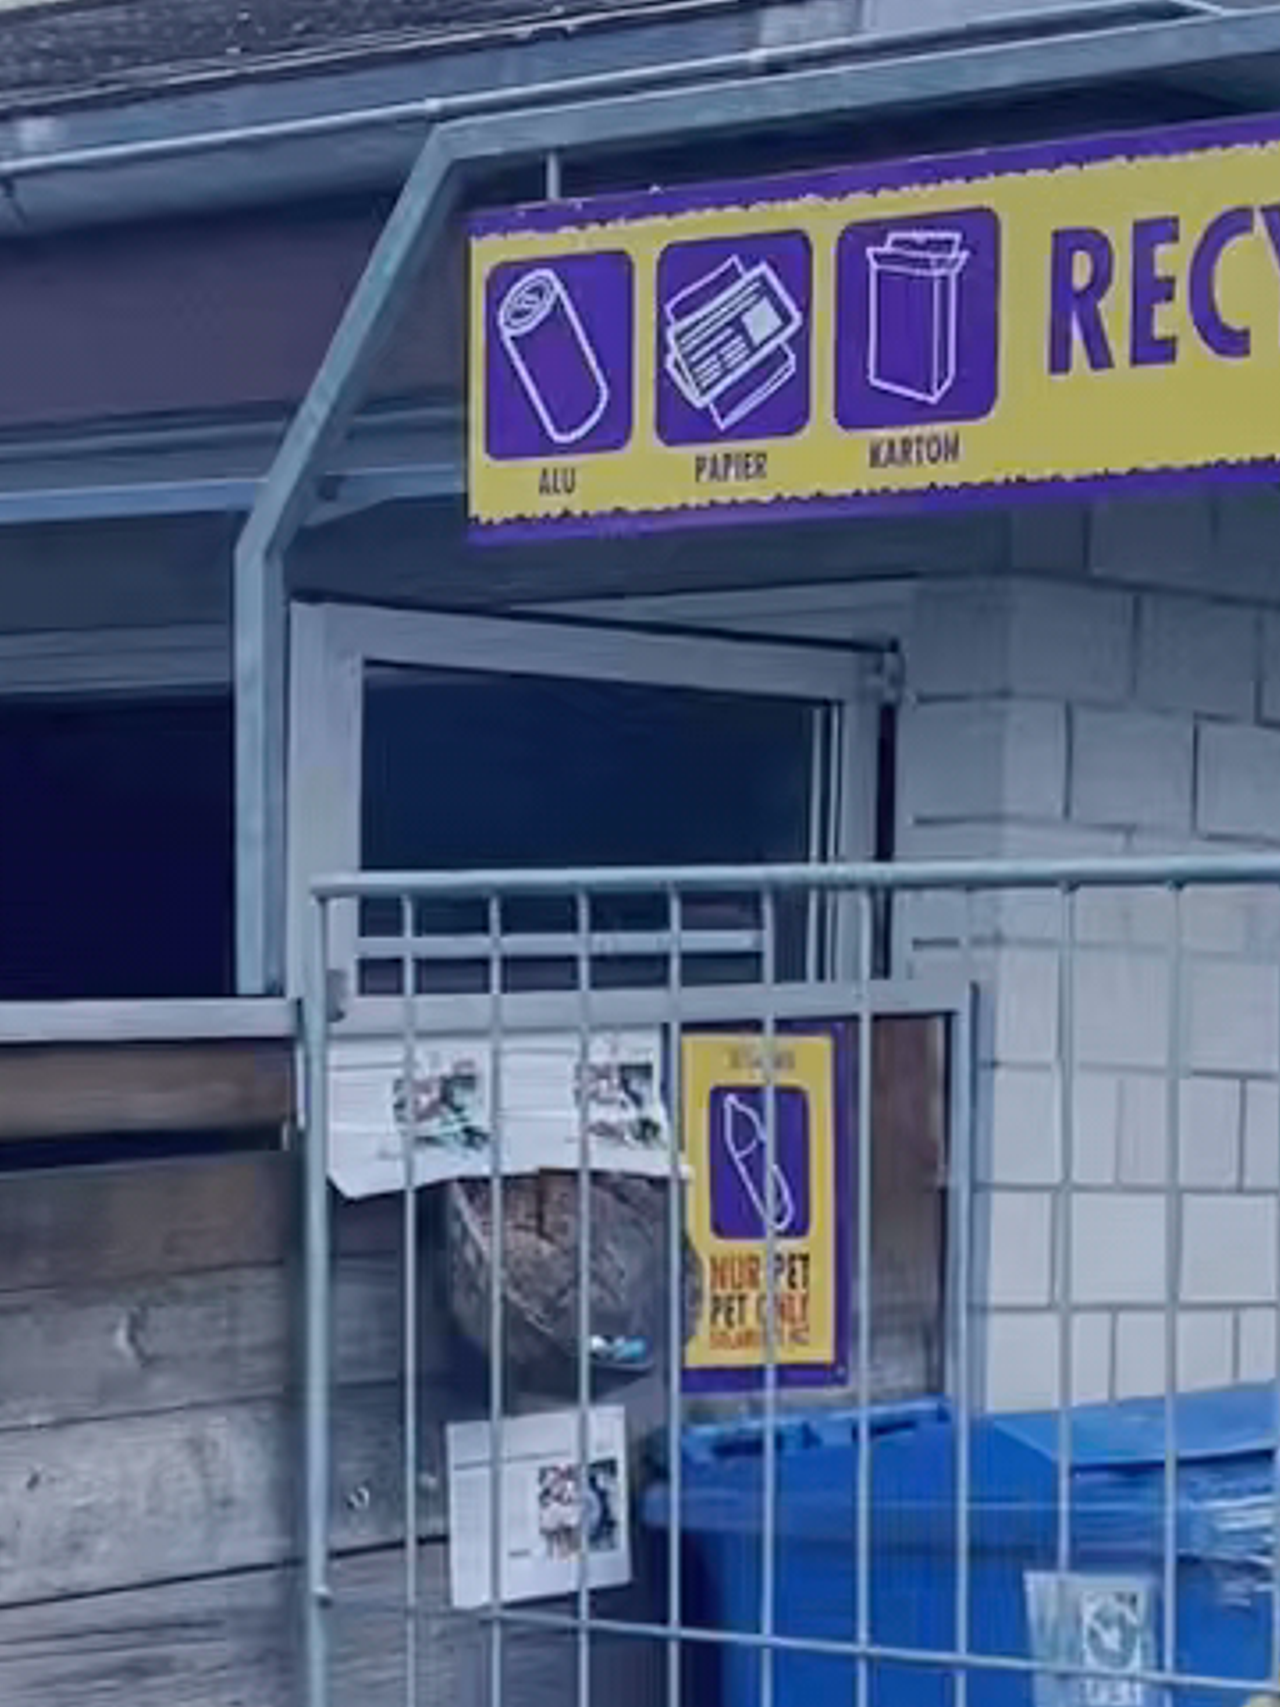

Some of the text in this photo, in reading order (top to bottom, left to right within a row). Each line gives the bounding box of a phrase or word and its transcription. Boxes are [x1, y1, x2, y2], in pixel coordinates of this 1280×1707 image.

[695, 450, 768, 482] PAPIER
[869, 431, 961, 468] KARTON
[538, 465, 577, 494] ALU
[710, 1294, 748, 1328] PET
